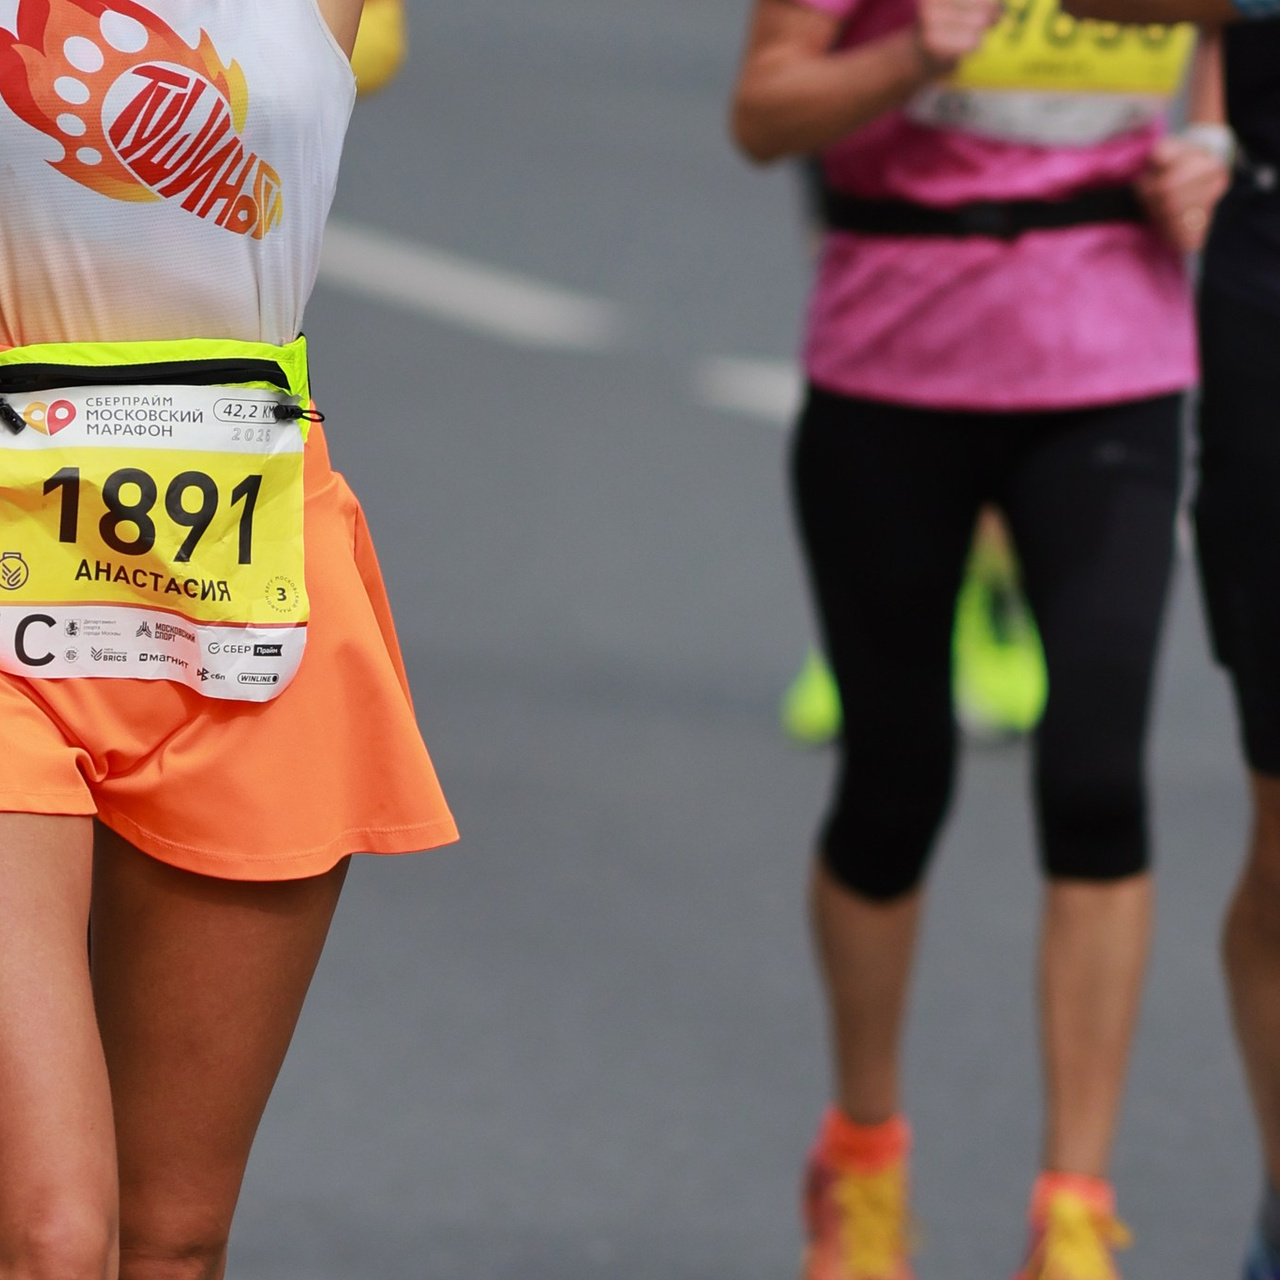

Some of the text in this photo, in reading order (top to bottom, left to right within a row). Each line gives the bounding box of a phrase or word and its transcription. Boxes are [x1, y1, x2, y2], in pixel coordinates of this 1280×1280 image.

[86, 394, 173, 407] СБЕРПРАЙМ
[86, 408, 203, 423] МОСКОВСКИЙ
[223, 403, 258, 420] 42,2
[86, 423, 173, 437] МАРАФОН
[43, 467, 263, 565] 1891
[74, 559, 232, 602] АНАСТАСИЯ
[276, 587, 287, 601] 3
[154, 631, 176, 642] СПОРТ
[155, 622, 196, 643] МОСКОВСКИЙ
[223, 645, 278, 654] СБЕР Прайм
[240, 675, 272, 683] WINLINE
